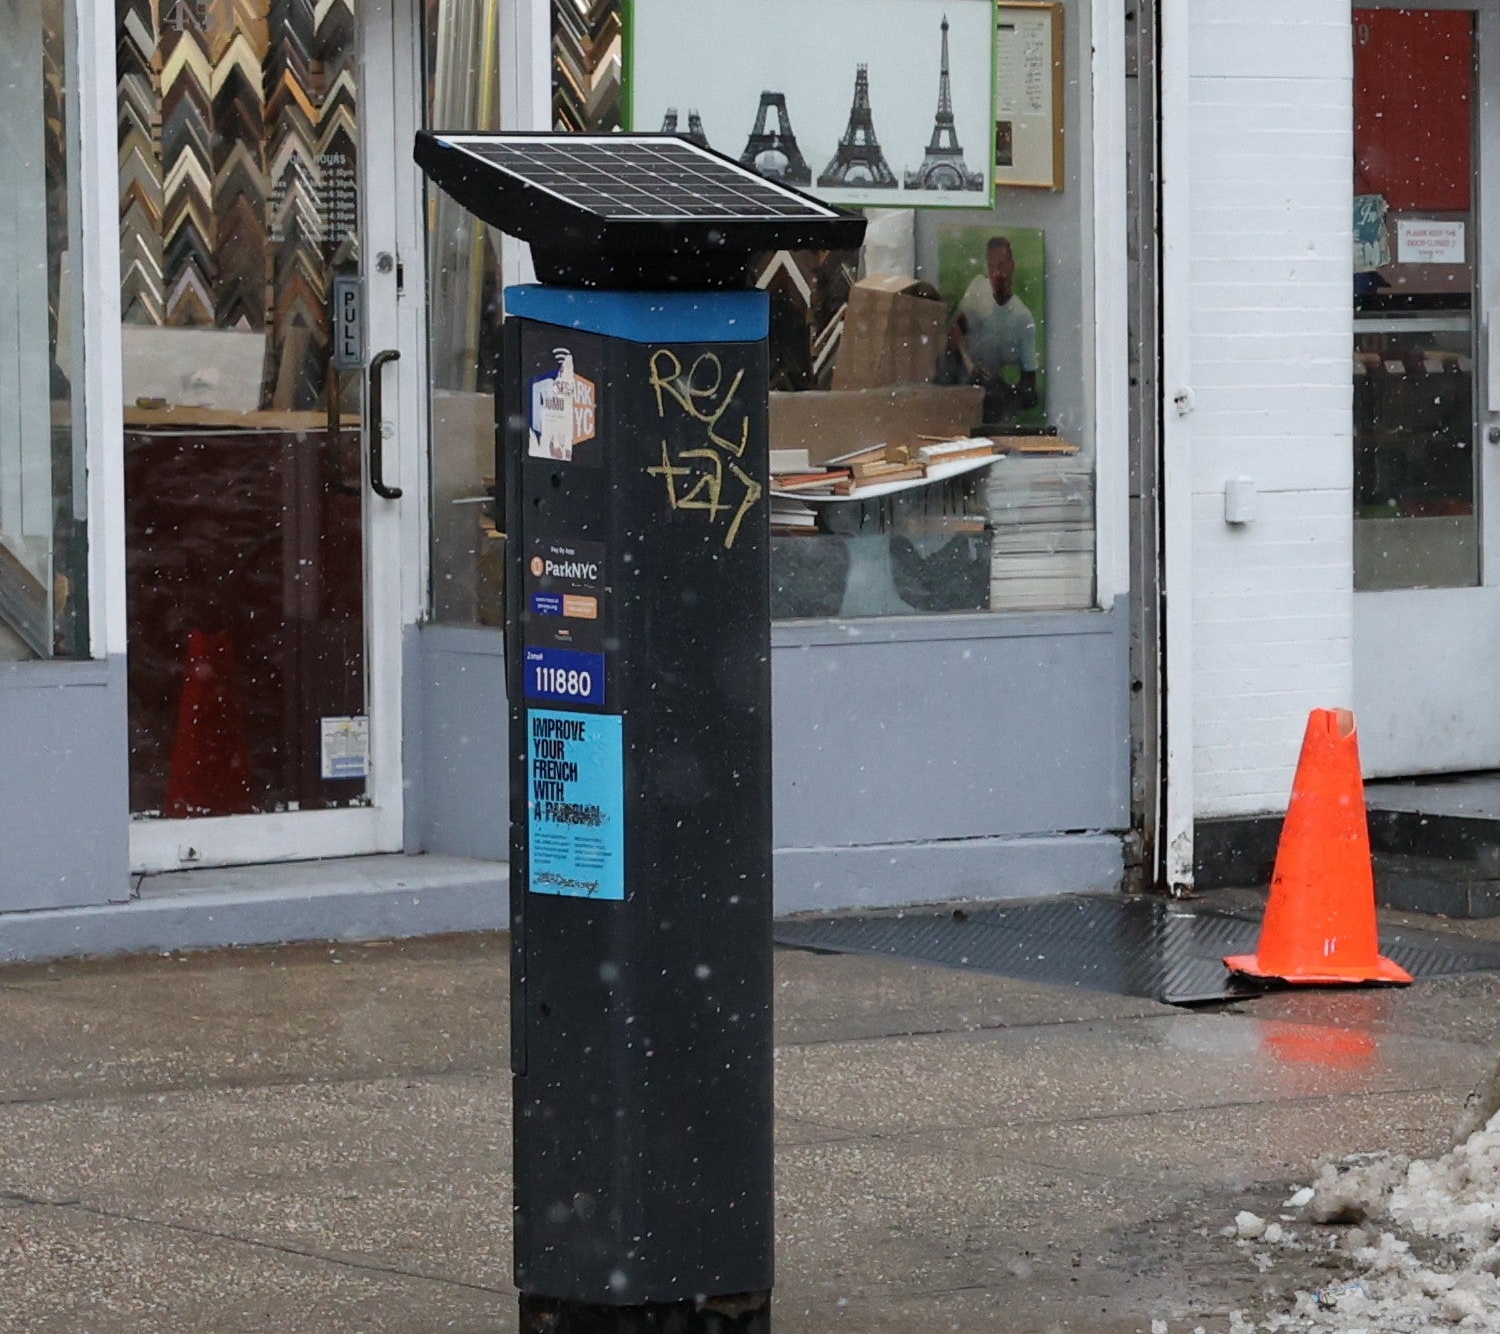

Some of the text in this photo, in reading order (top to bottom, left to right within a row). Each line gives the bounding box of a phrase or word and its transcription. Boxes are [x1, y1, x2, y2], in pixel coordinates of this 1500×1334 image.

[344, 291, 356, 356] PULL
[545, 559, 598, 580] ParkNYC
[535, 666, 591, 697] 111880
[532, 716, 586, 742] IMPROVE
[532, 738, 565, 760] YOUR
[532, 759, 578, 782] FRENCH
[533, 779, 565, 802] WITH
[533, 801, 542, 822] A
